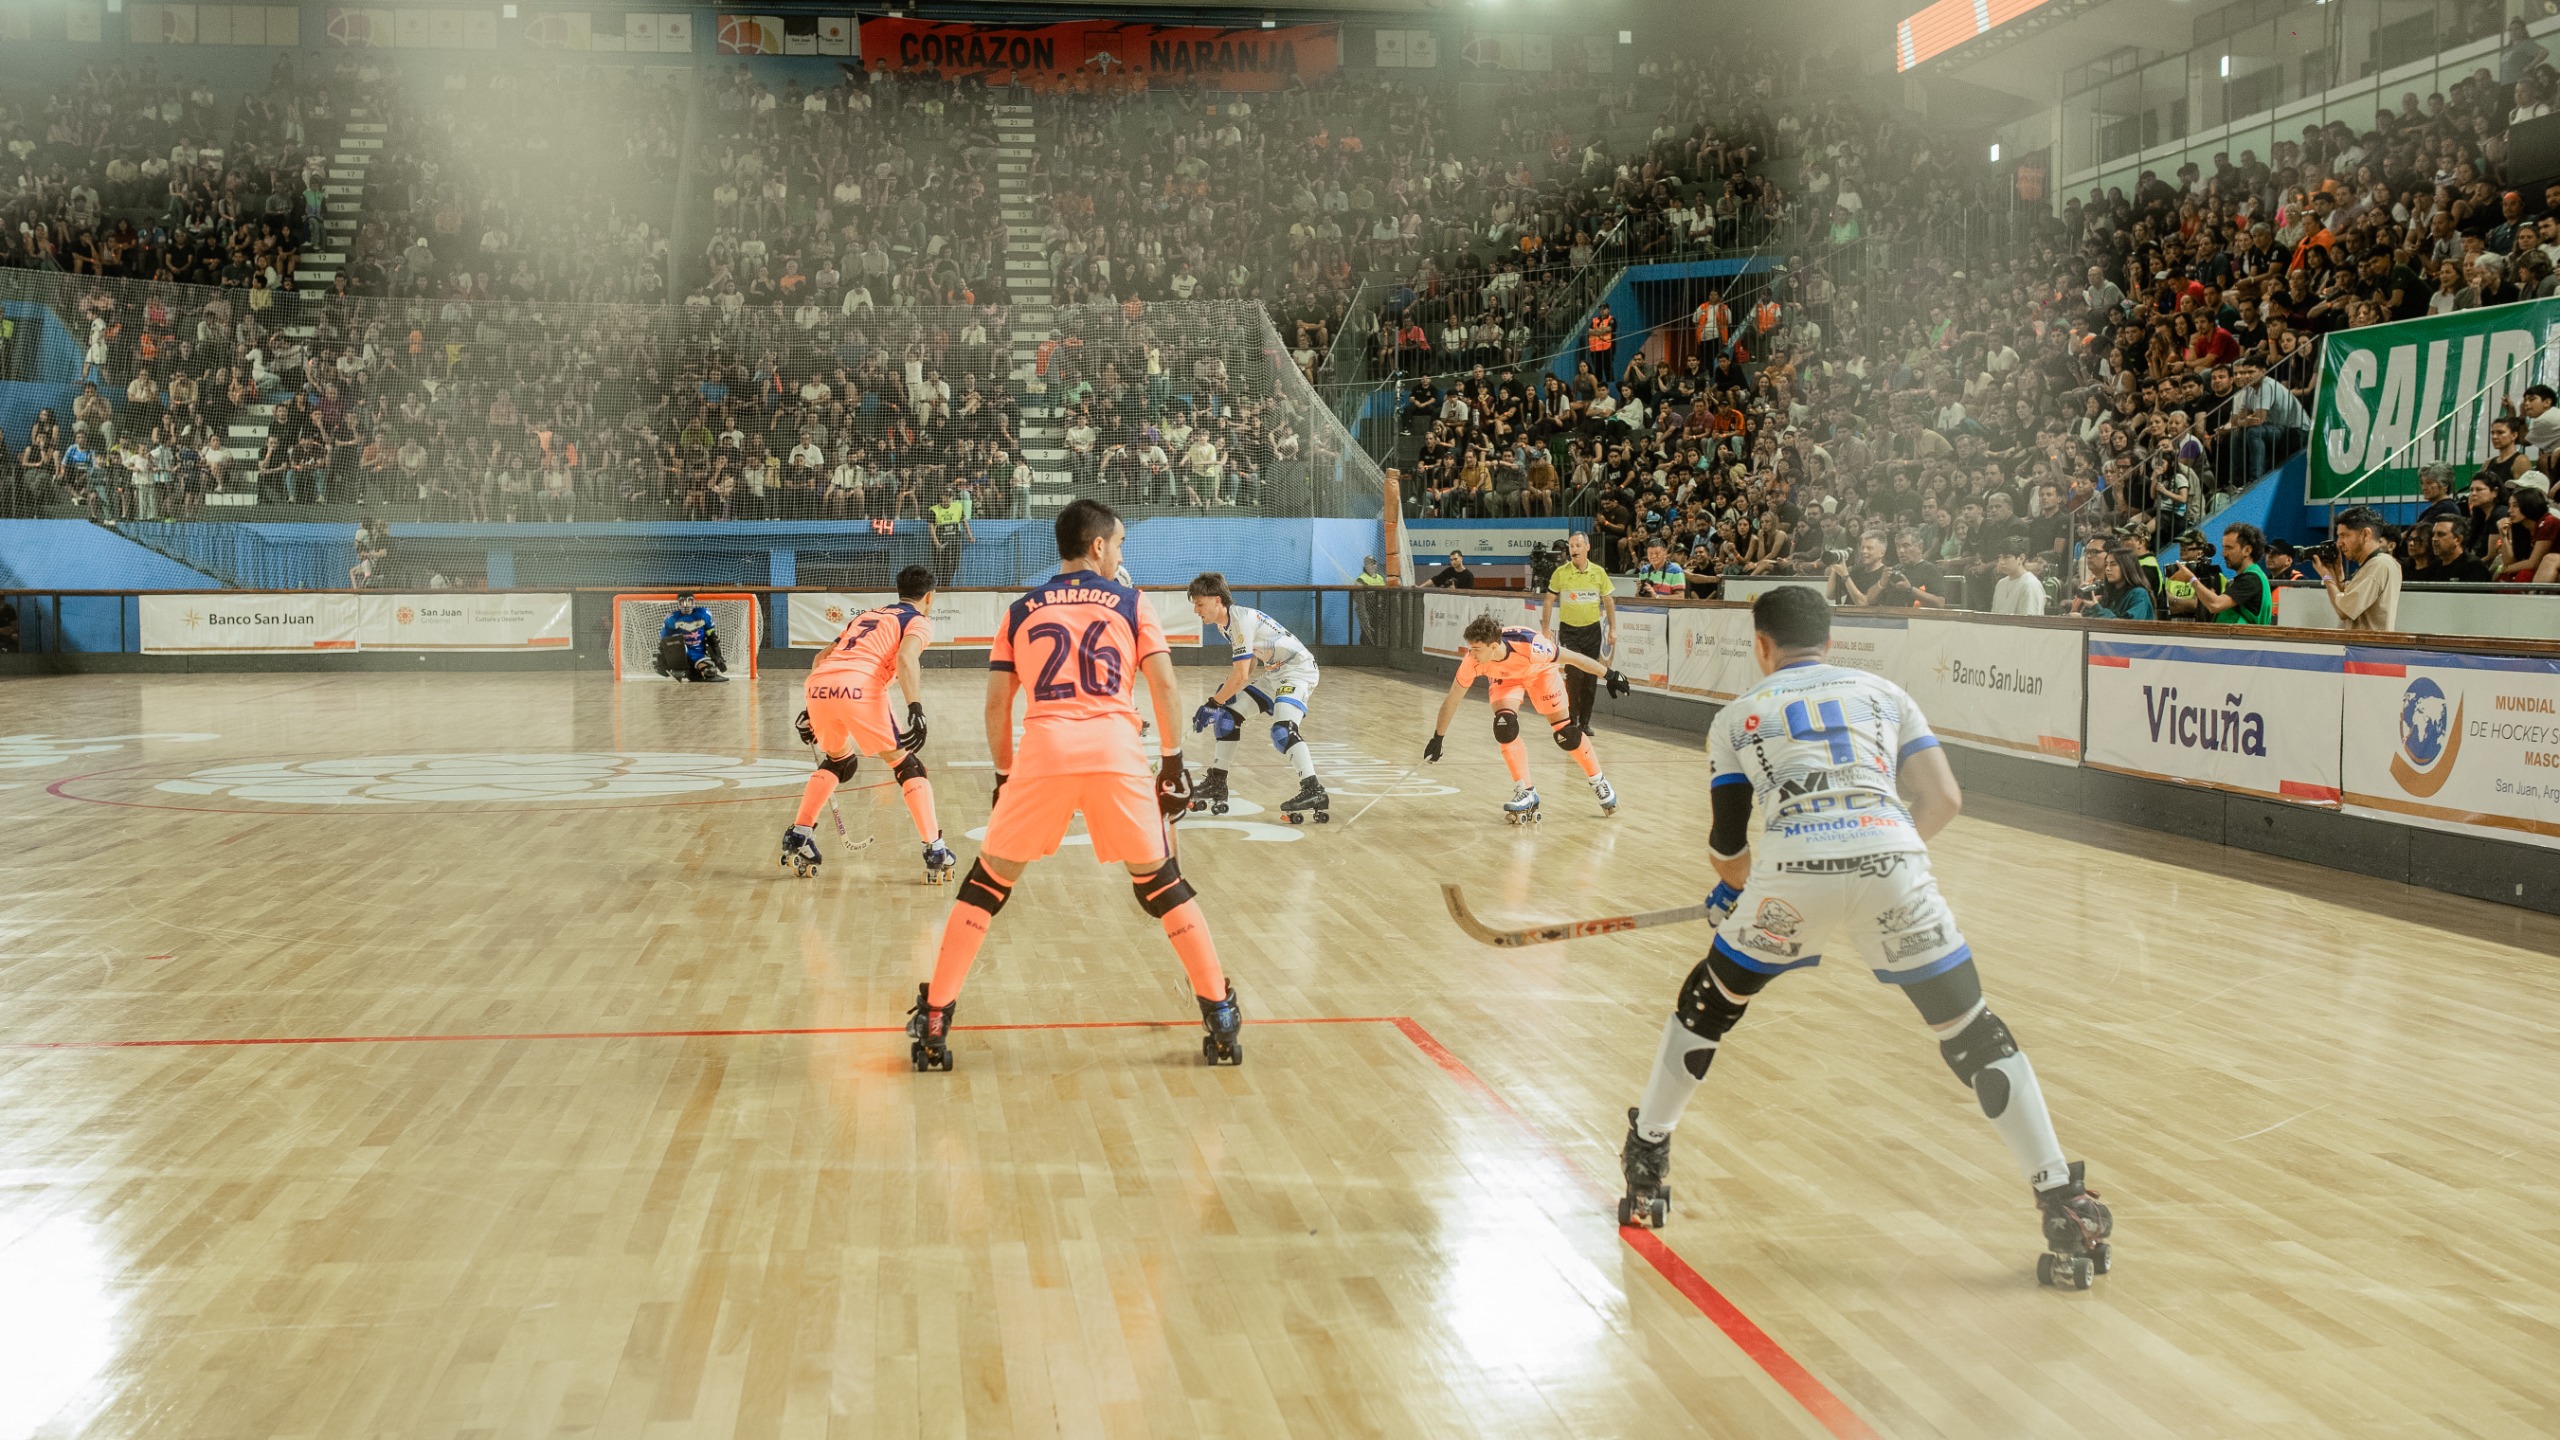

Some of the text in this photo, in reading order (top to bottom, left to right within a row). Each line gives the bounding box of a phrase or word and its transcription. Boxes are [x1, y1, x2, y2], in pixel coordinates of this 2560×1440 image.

[901, 32, 1054, 70] CORAZON
[1149, 40, 1296, 73] NARANJA
[2327, 324, 2560, 475] SALID
[872, 518, 894, 535] 44
[1045, 588, 1121, 609] BARROSO
[209, 613, 314, 625] Banco San Juan
[421, 608, 462, 617] San Juan
[843, 619, 880, 651] 7
[1027, 620, 1122, 702] 26
[1821, 680, 1857, 689] Travel
[1953, 660, 2043, 695] Banco San Juan
[2495, 695, 2556, 714] MUNDIAL
[1780, 696, 1860, 769] 4
[2142, 685, 2267, 757] Vicuña
[2470, 720, 2488, 738] DE
[2491, 723, 2549, 743] HOCKEY
[2495, 778, 2514, 793] San
[2516, 782, 2541, 799] Juan,
[1784, 815, 1899, 838] MundoPan
[1806, 829, 1884, 843] PANIFICADORA
